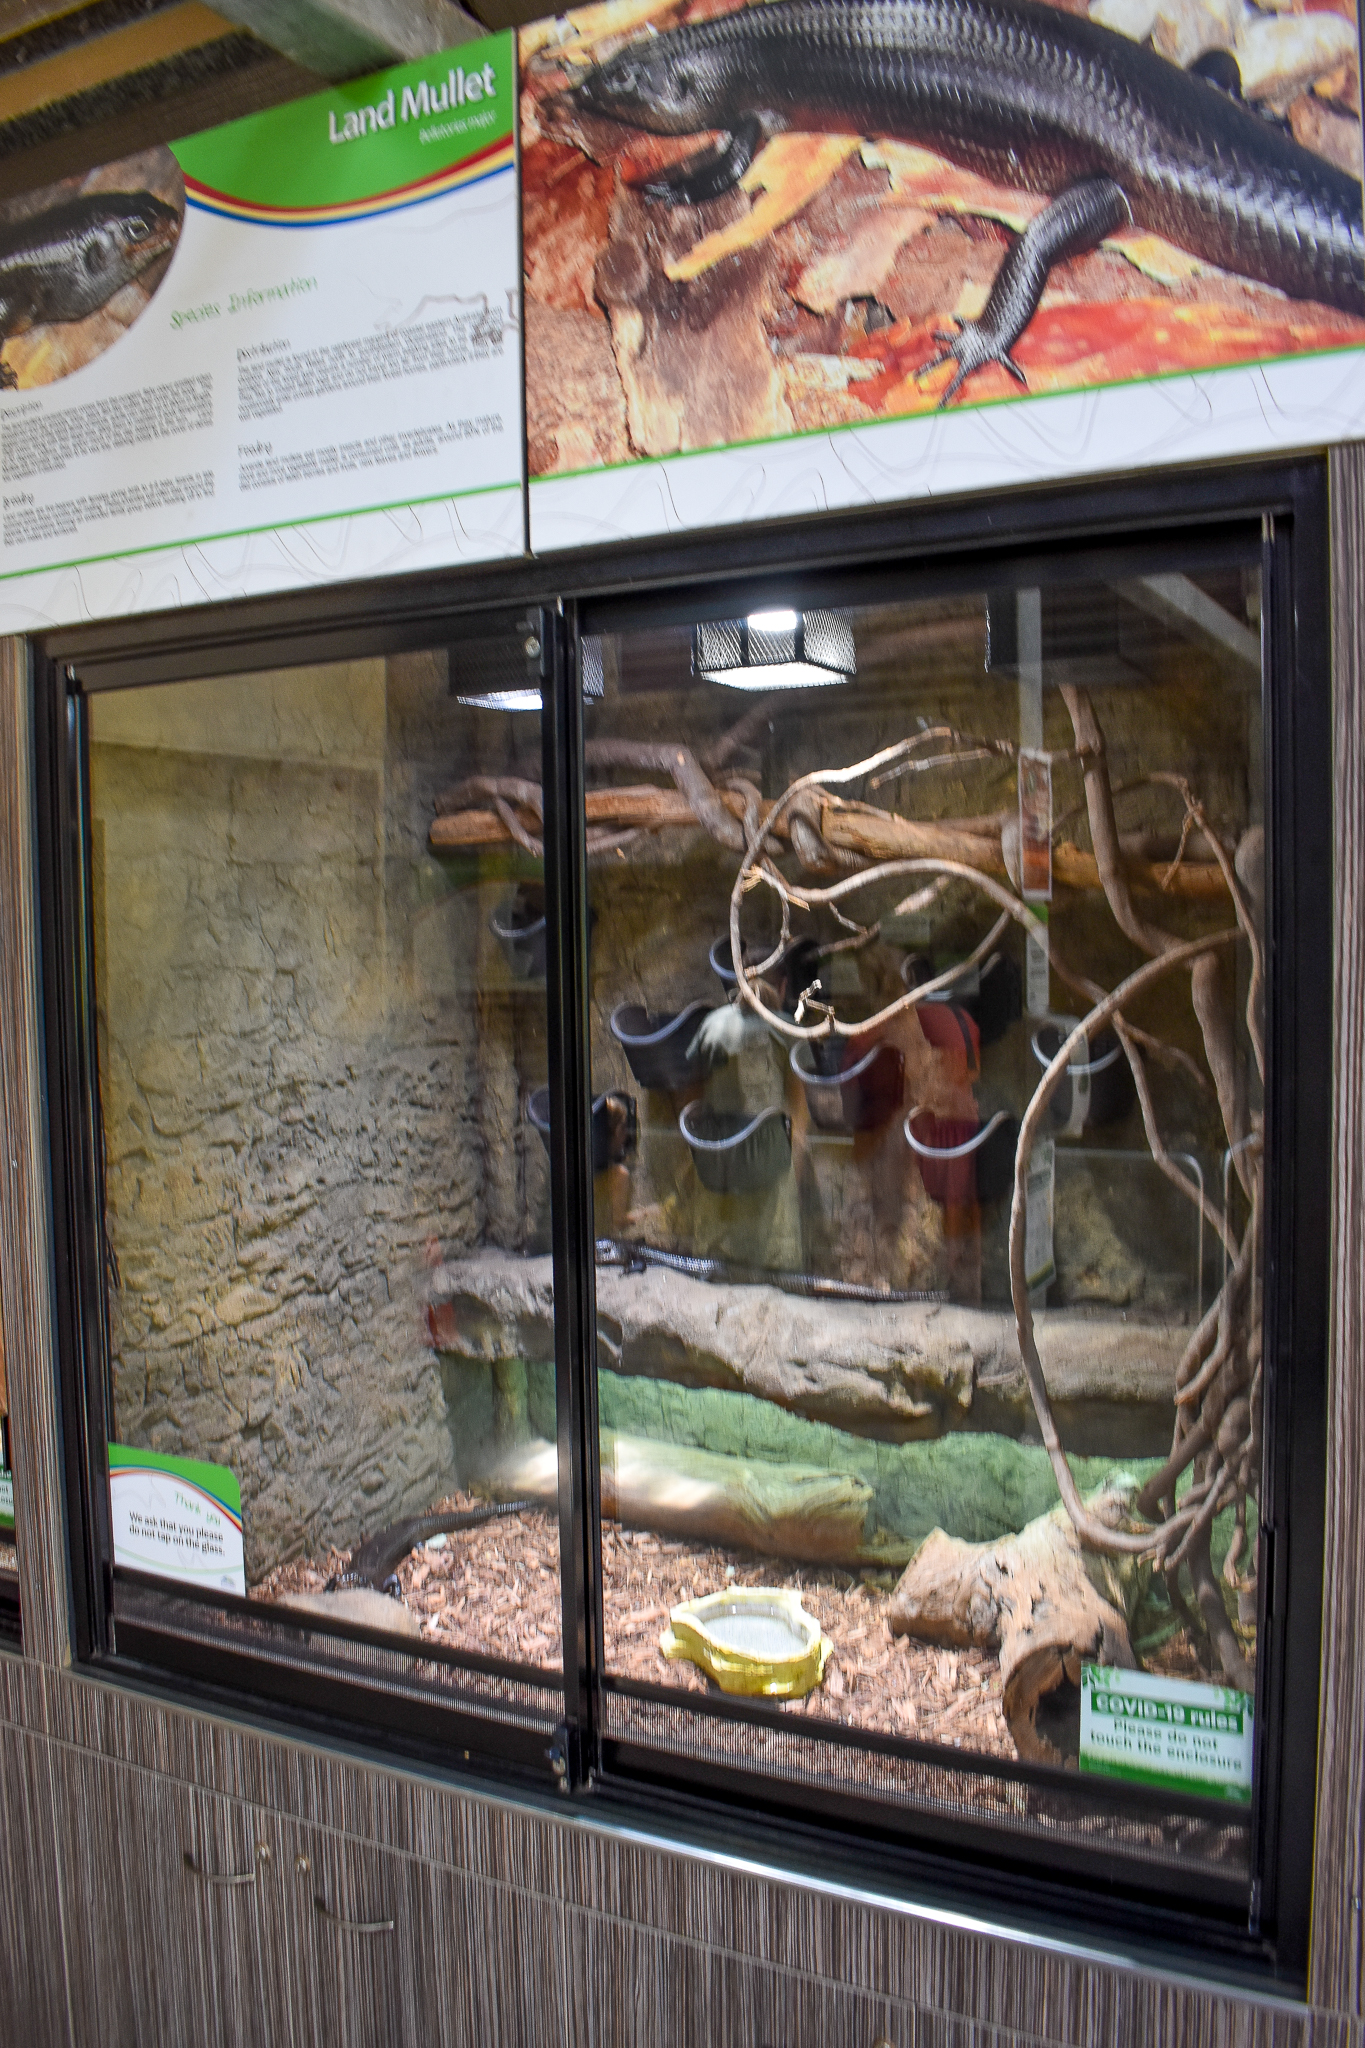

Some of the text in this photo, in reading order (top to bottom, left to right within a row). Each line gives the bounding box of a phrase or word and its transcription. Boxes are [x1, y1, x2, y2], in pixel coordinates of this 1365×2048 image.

[329, 62, 497, 145] Land Mullet
[228, 276, 318, 314] Information
[175, 1490, 201, 1514] Thank
[129, 1511, 224, 1541] We ask that you please
[129, 1524, 226, 1556] do not tap on the glass.
[1096, 1692, 1238, 1732] COVID-19 rules
[1091, 1728, 1242, 1772] touch the enclosure
[1114, 1718, 1217, 1751] Please do not
